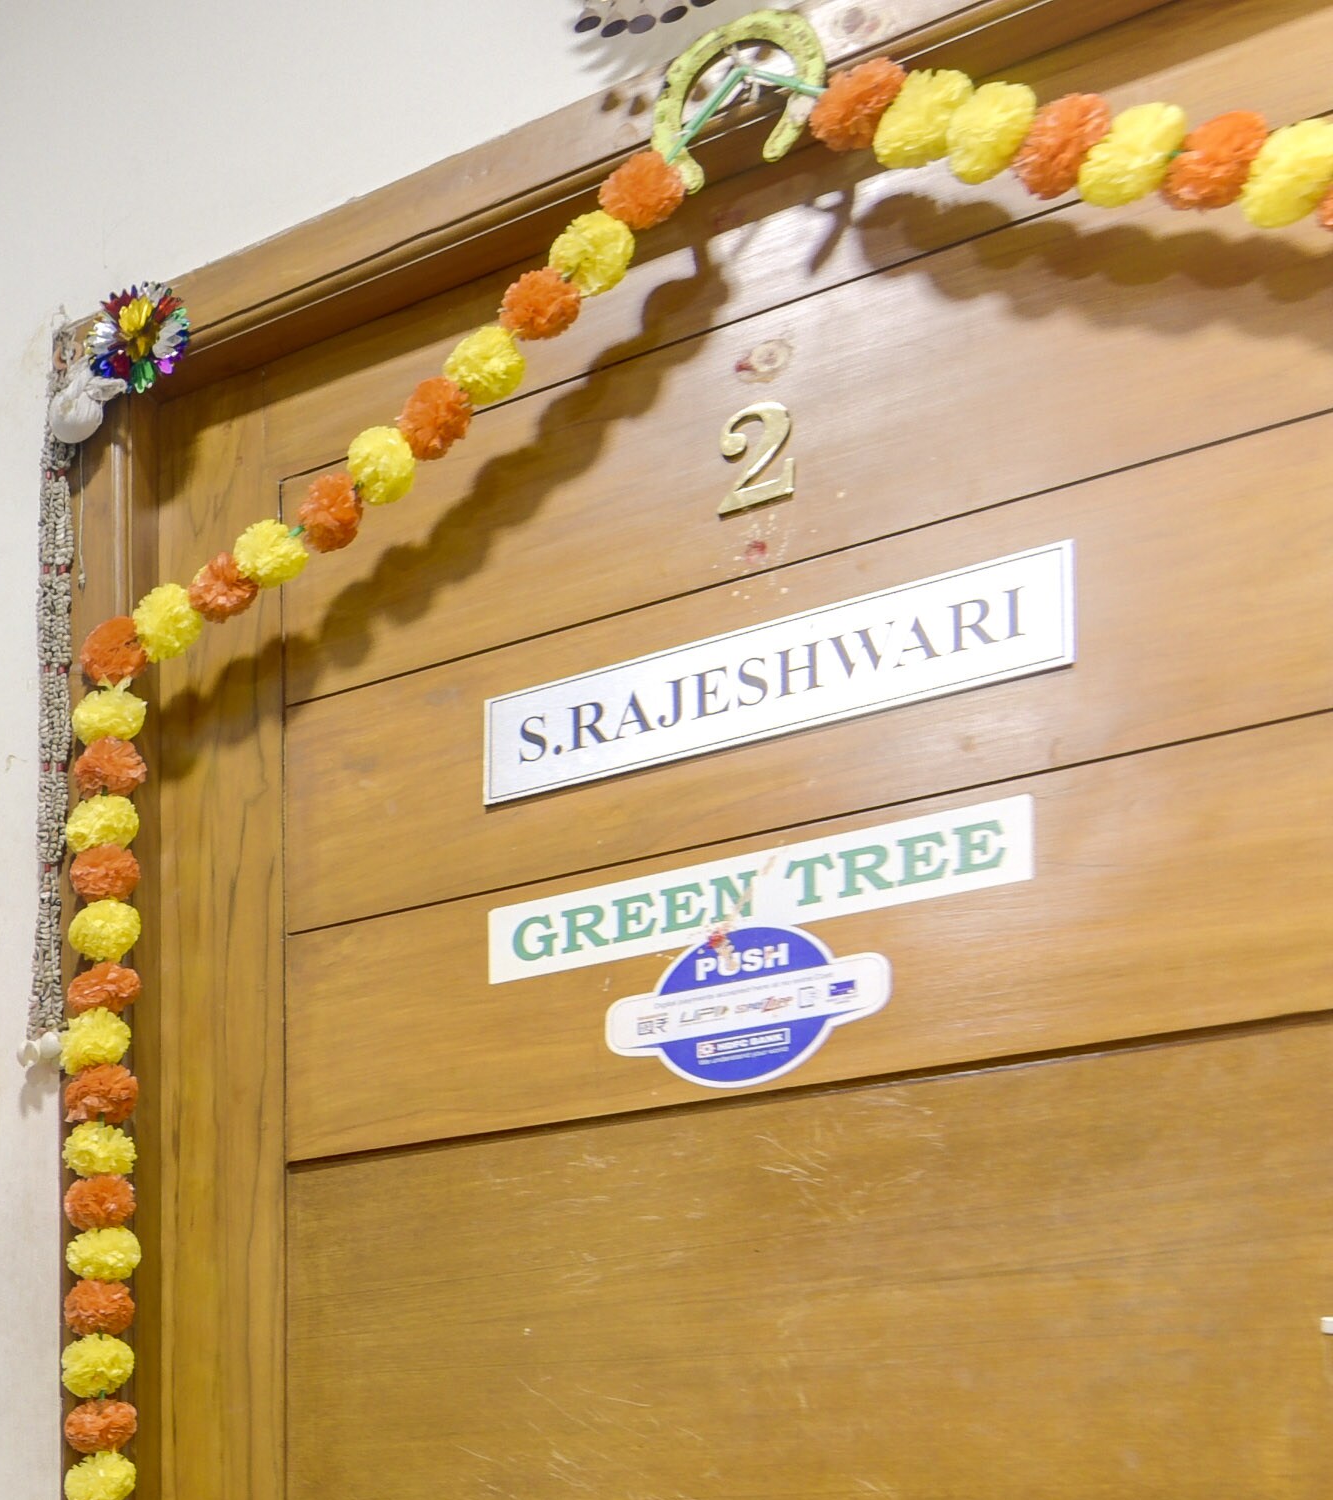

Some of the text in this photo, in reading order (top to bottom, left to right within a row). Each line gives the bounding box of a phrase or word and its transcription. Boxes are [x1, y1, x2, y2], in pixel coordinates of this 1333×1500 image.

[717, 401, 796, 516] 2
[517, 585, 1027, 765] S.RAJESHWARI
[512, 819, 1007, 962] GREEN TREE
[695, 942, 790, 981] PUSH
